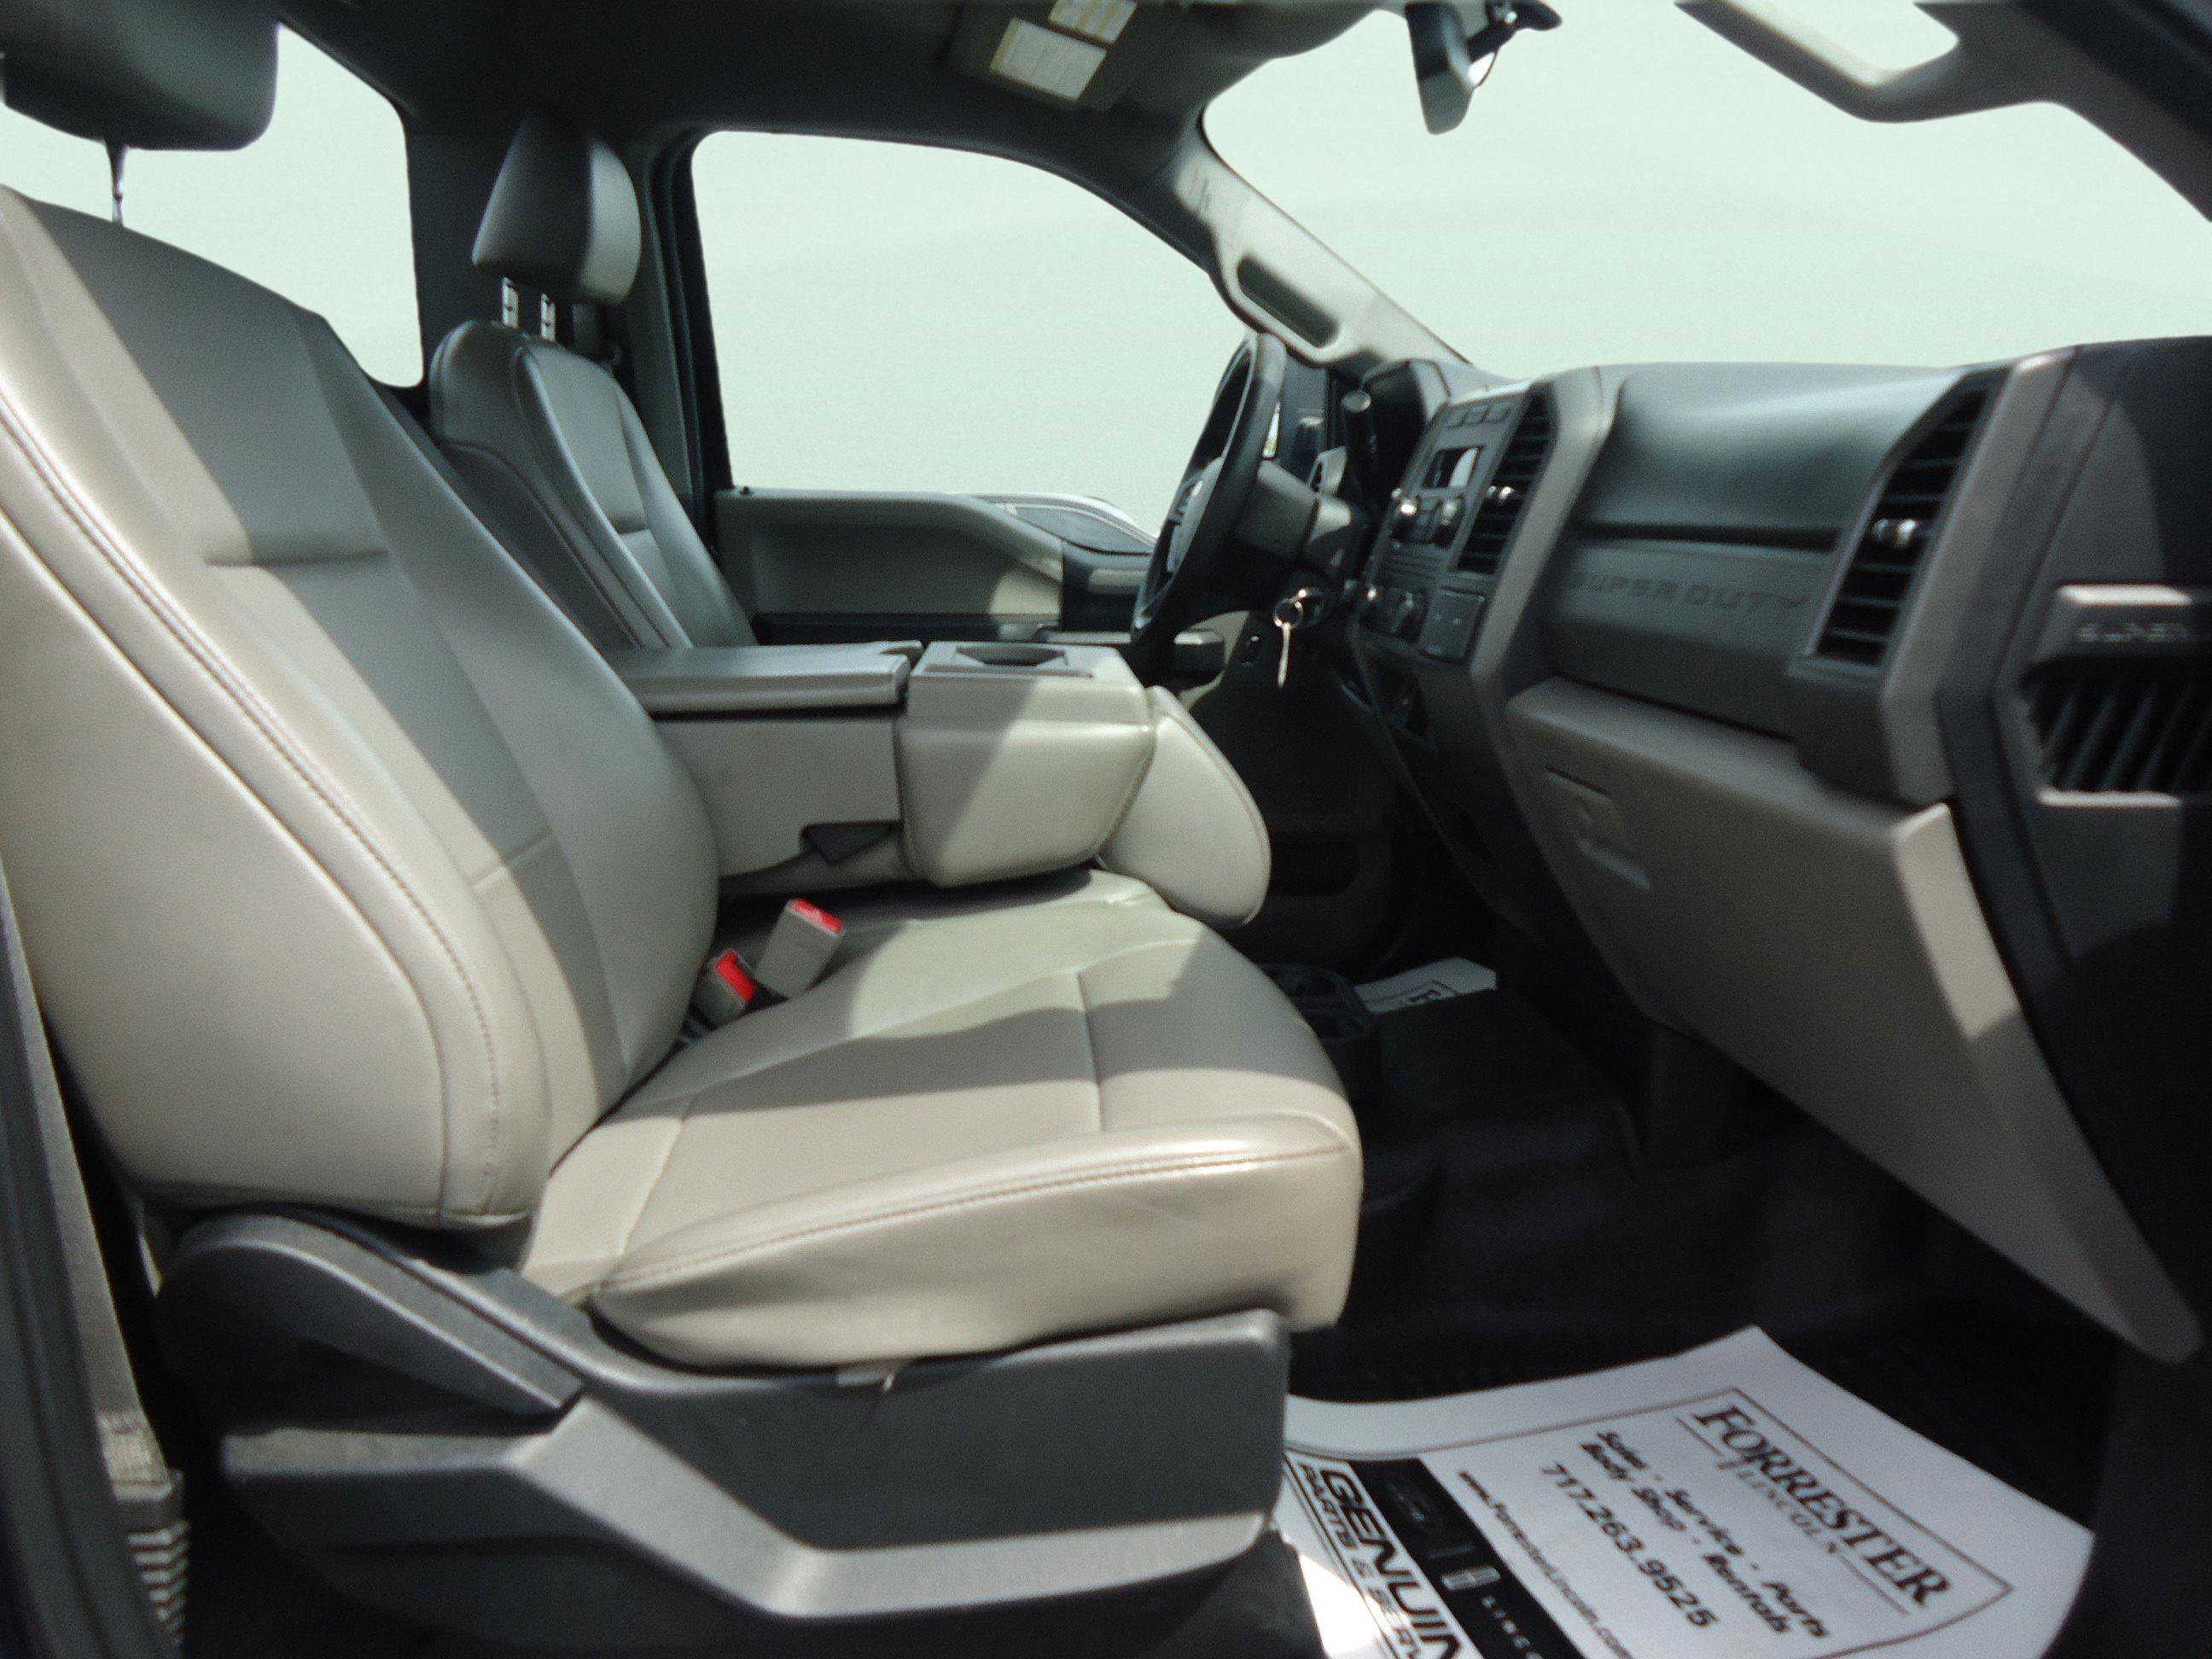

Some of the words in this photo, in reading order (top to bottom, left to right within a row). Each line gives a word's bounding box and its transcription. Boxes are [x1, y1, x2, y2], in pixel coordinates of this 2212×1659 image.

[1567, 571, 1679, 601] SUPER
[1683, 584, 1810, 617] DUTY
[1692, 1405, 1951, 1608] FORRESTER
[1761, 1581, 1831, 1639] Parts
